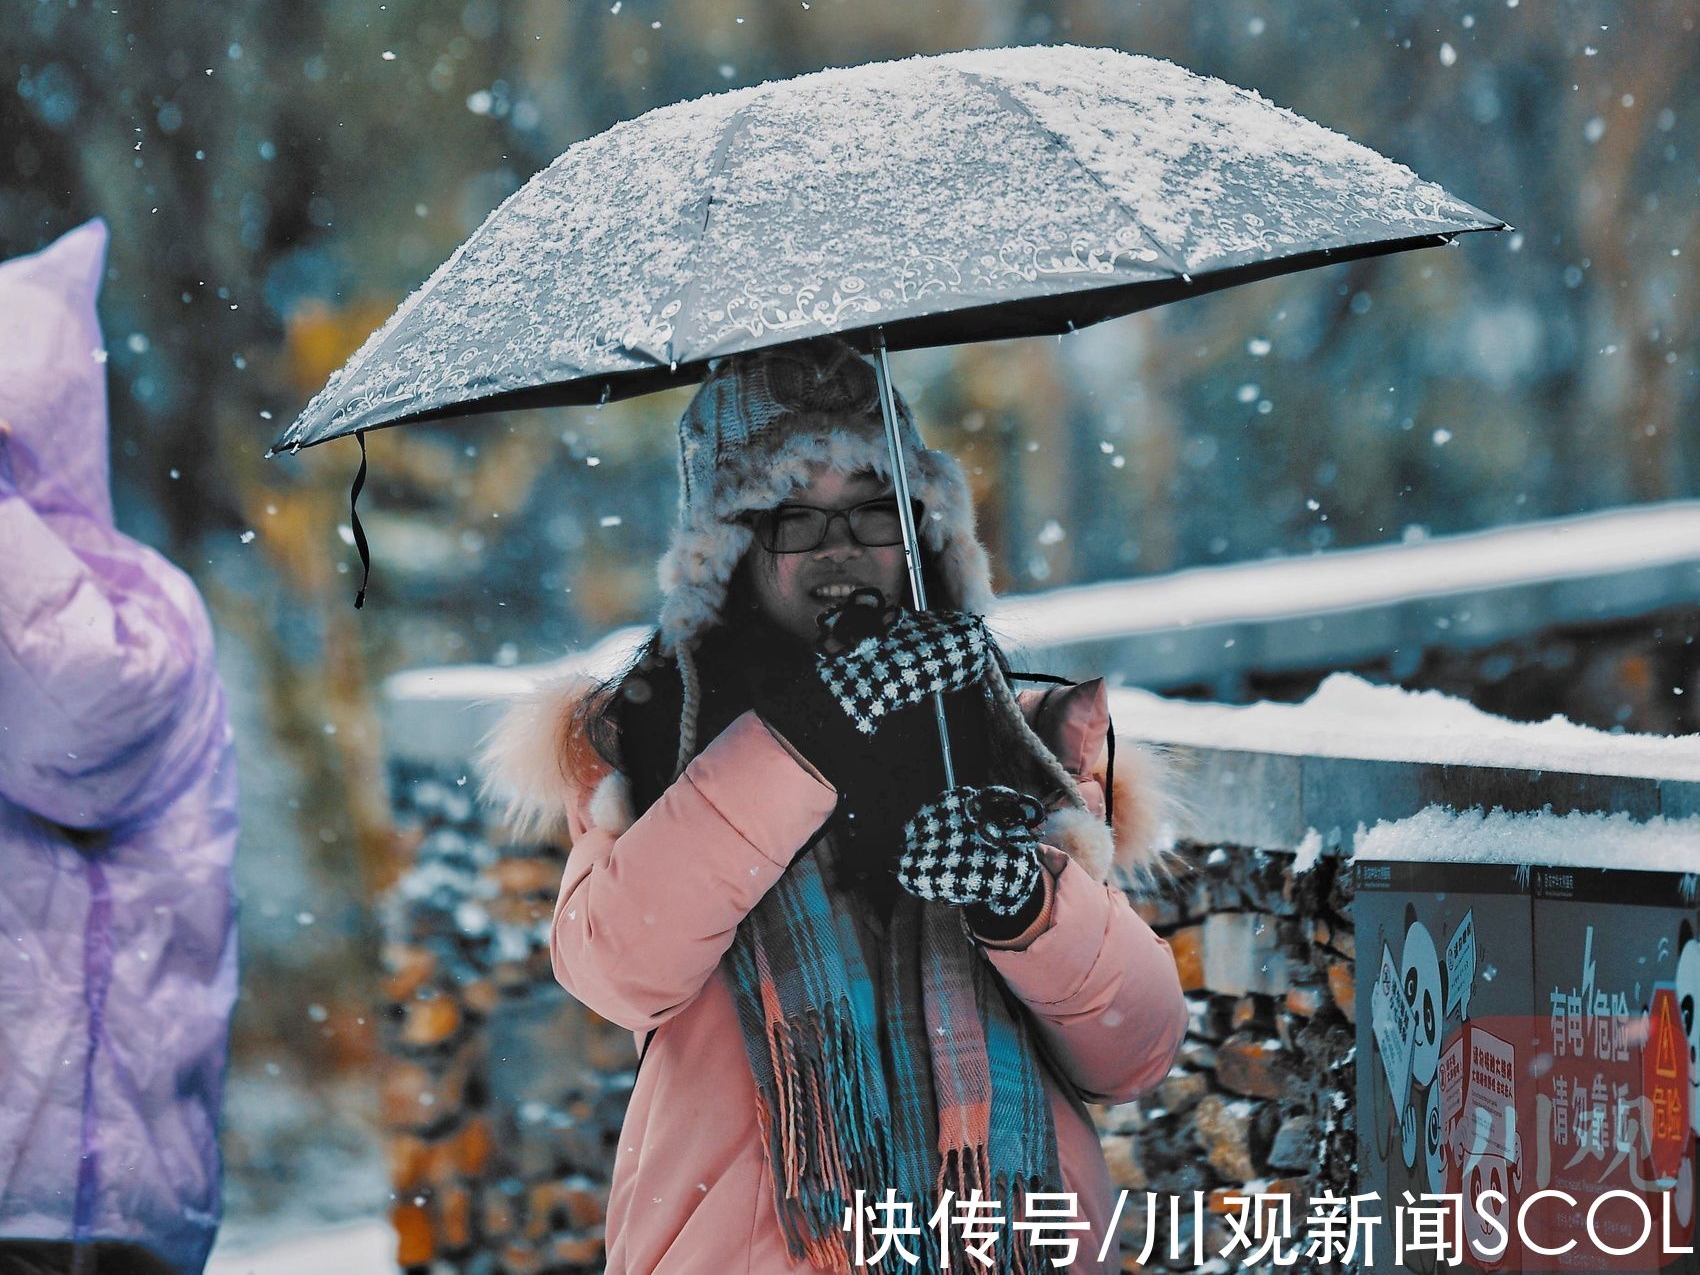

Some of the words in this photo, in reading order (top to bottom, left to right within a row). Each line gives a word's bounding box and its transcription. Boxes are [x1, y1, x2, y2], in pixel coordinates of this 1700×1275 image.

[1550, 986, 1631, 1062] 有电危险
[1552, 1073, 1631, 1153] 请勿靠近
[1652, 1085, 1682, 1141] 危险
